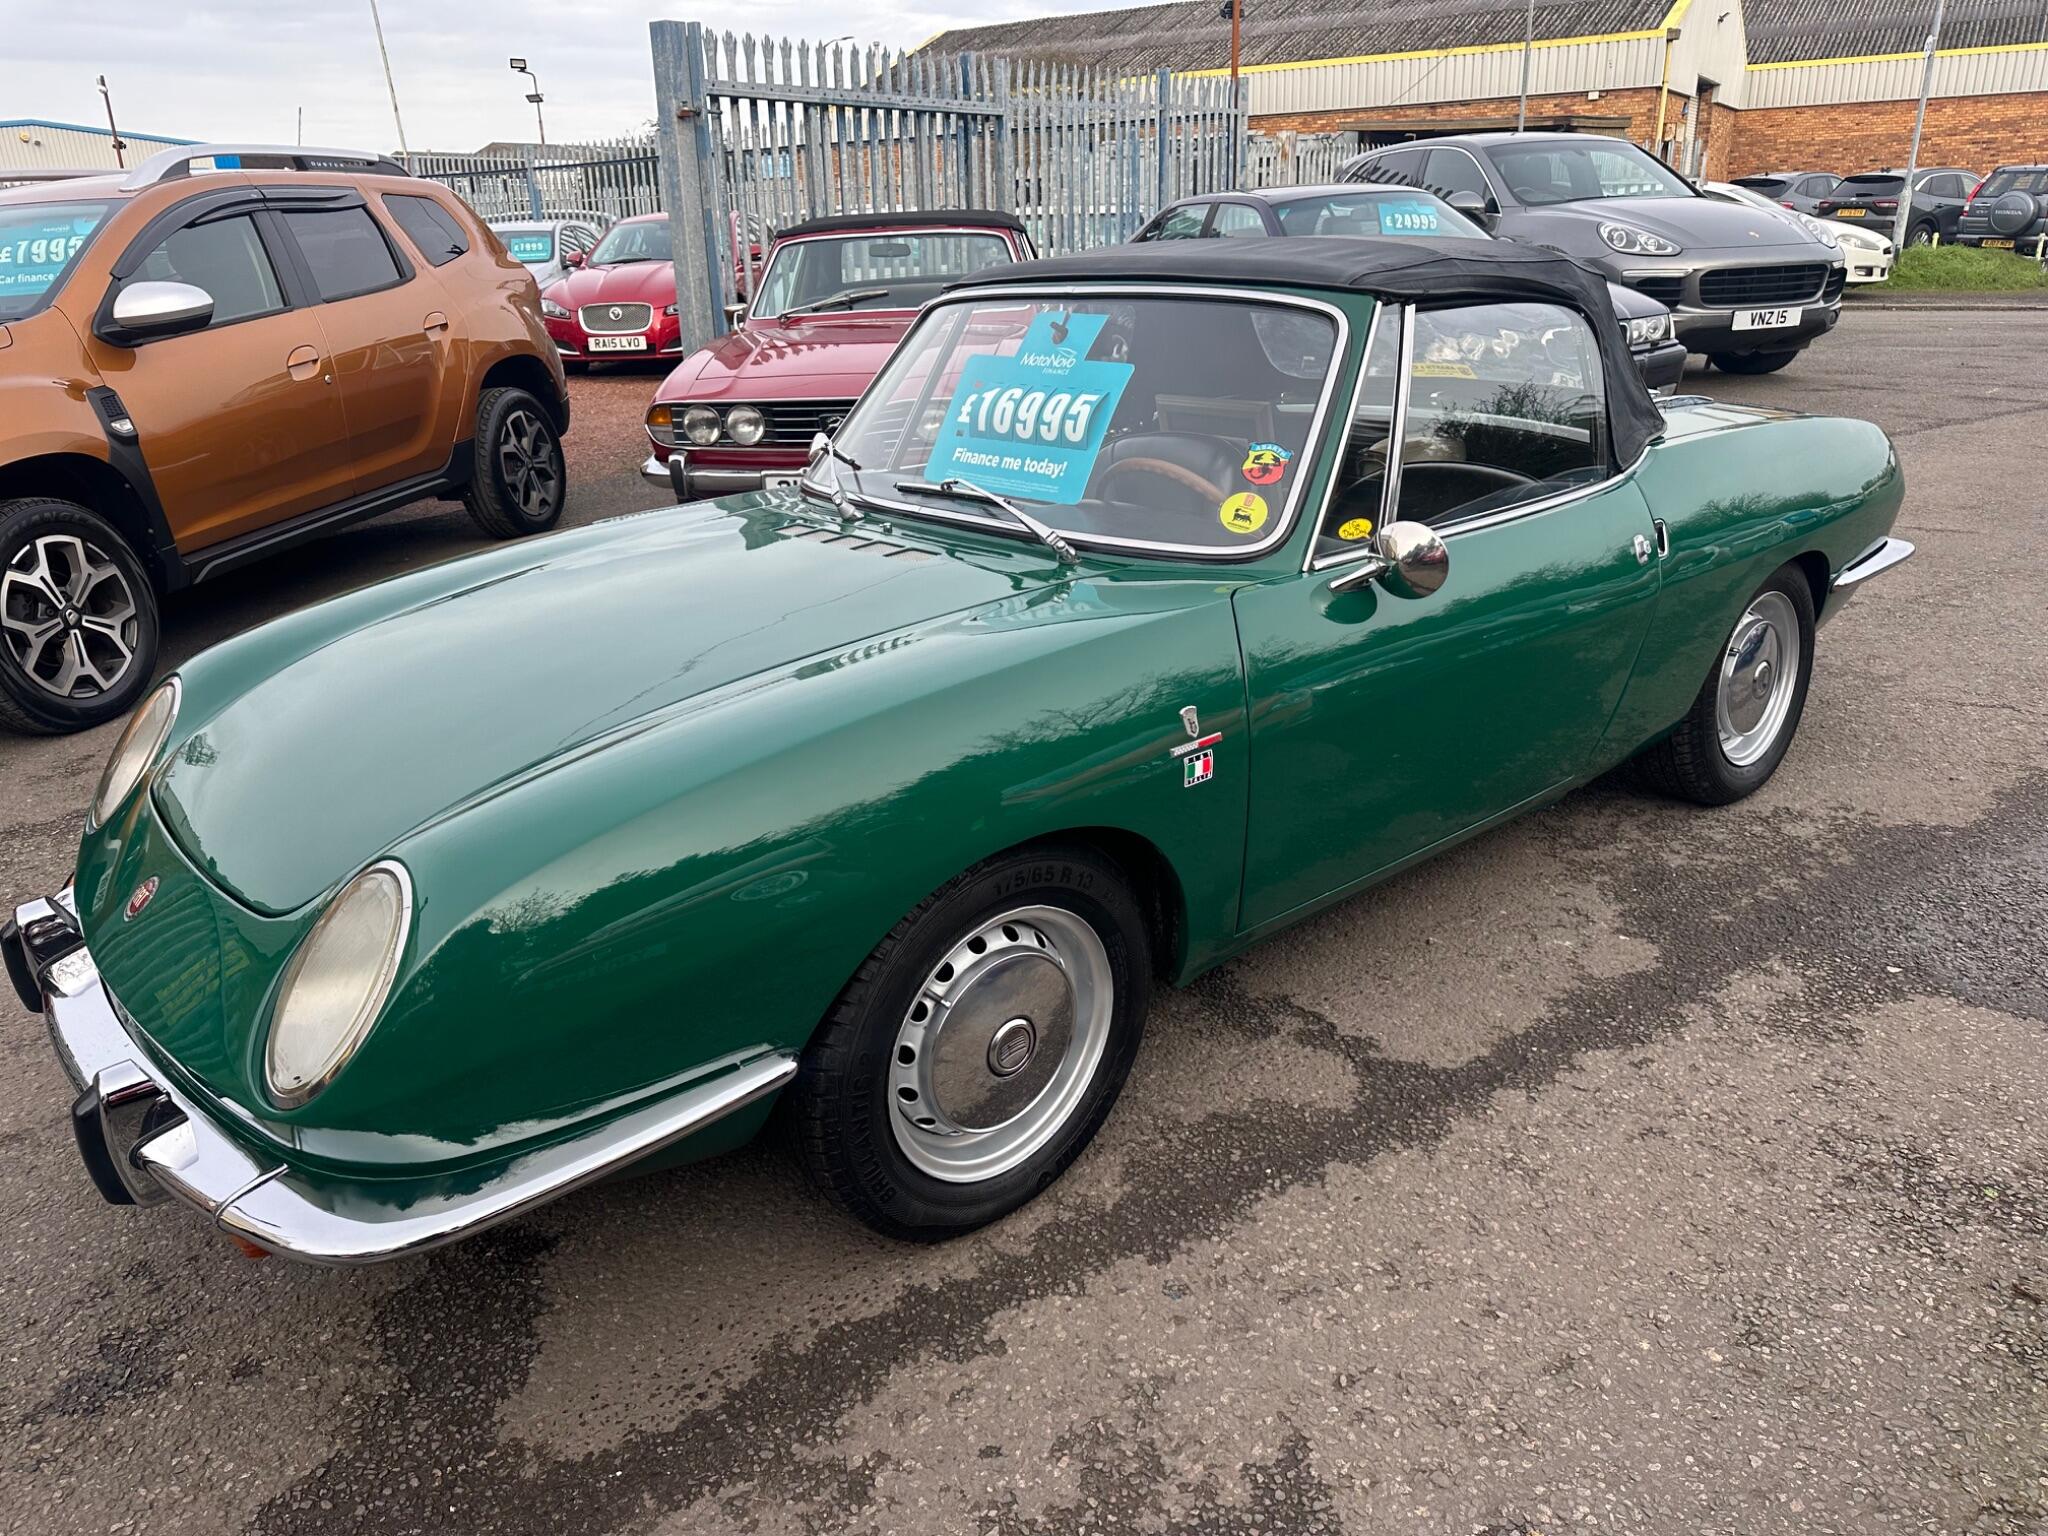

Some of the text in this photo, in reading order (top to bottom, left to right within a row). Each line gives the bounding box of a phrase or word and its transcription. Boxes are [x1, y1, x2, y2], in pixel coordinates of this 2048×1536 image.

[17, 272, 55, 283] finance
[1750, 309, 1788, 326] VNZ 15
[594, 338, 617, 349] RA15
[1019, 350, 1077, 369] MotoNovo
[1041, 367, 1071, 376] FINANCE
[957, 387, 1099, 443] £16995
[952, 447, 1067, 479] Finance me today!
